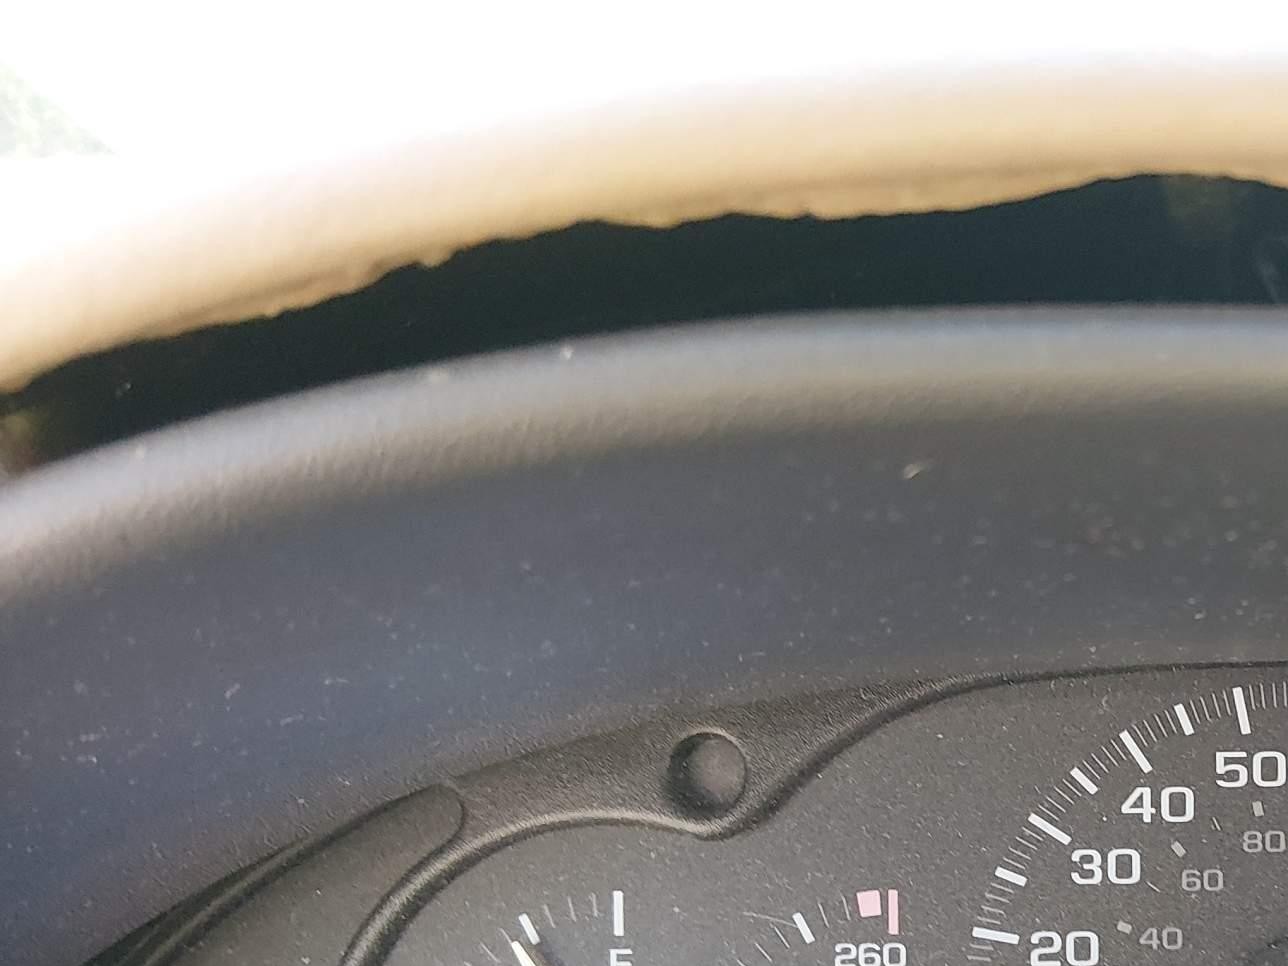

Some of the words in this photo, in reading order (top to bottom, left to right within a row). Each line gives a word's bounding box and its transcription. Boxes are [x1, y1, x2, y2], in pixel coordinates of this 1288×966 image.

[1215, 751, 1287, 787] 50
[1121, 787, 1195, 823] 40
[1243, 831, 1286, 852] 80
[1070, 849, 1141, 885] 30
[1180, 869, 1224, 892] 60
[1030, 931, 1099, 966] 20
[1139, 928, 1183, 950] 40
